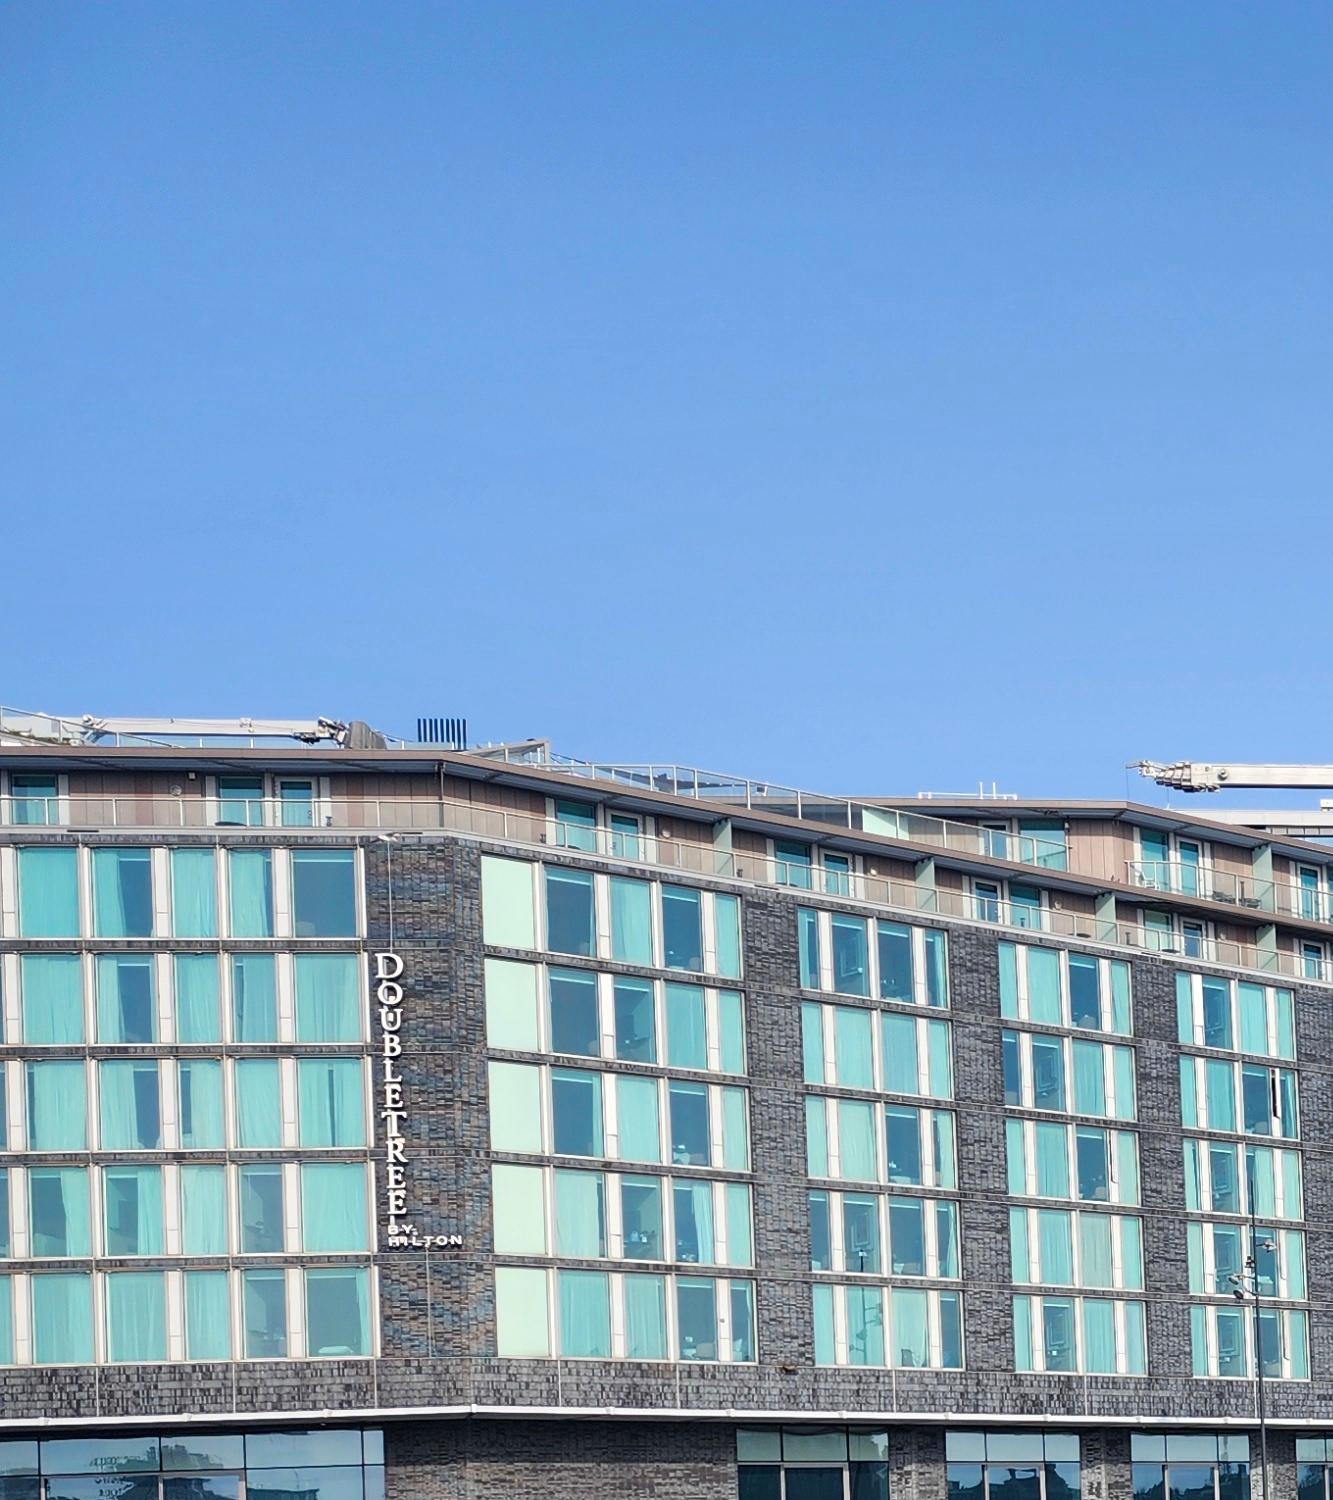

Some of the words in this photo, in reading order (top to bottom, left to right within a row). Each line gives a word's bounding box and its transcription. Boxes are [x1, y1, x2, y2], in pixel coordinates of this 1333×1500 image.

[374, 952, 408, 1215] DOUBLETREE
[387, 1225, 413, 1235] BY
[387, 1235, 463, 1247] HILTON
